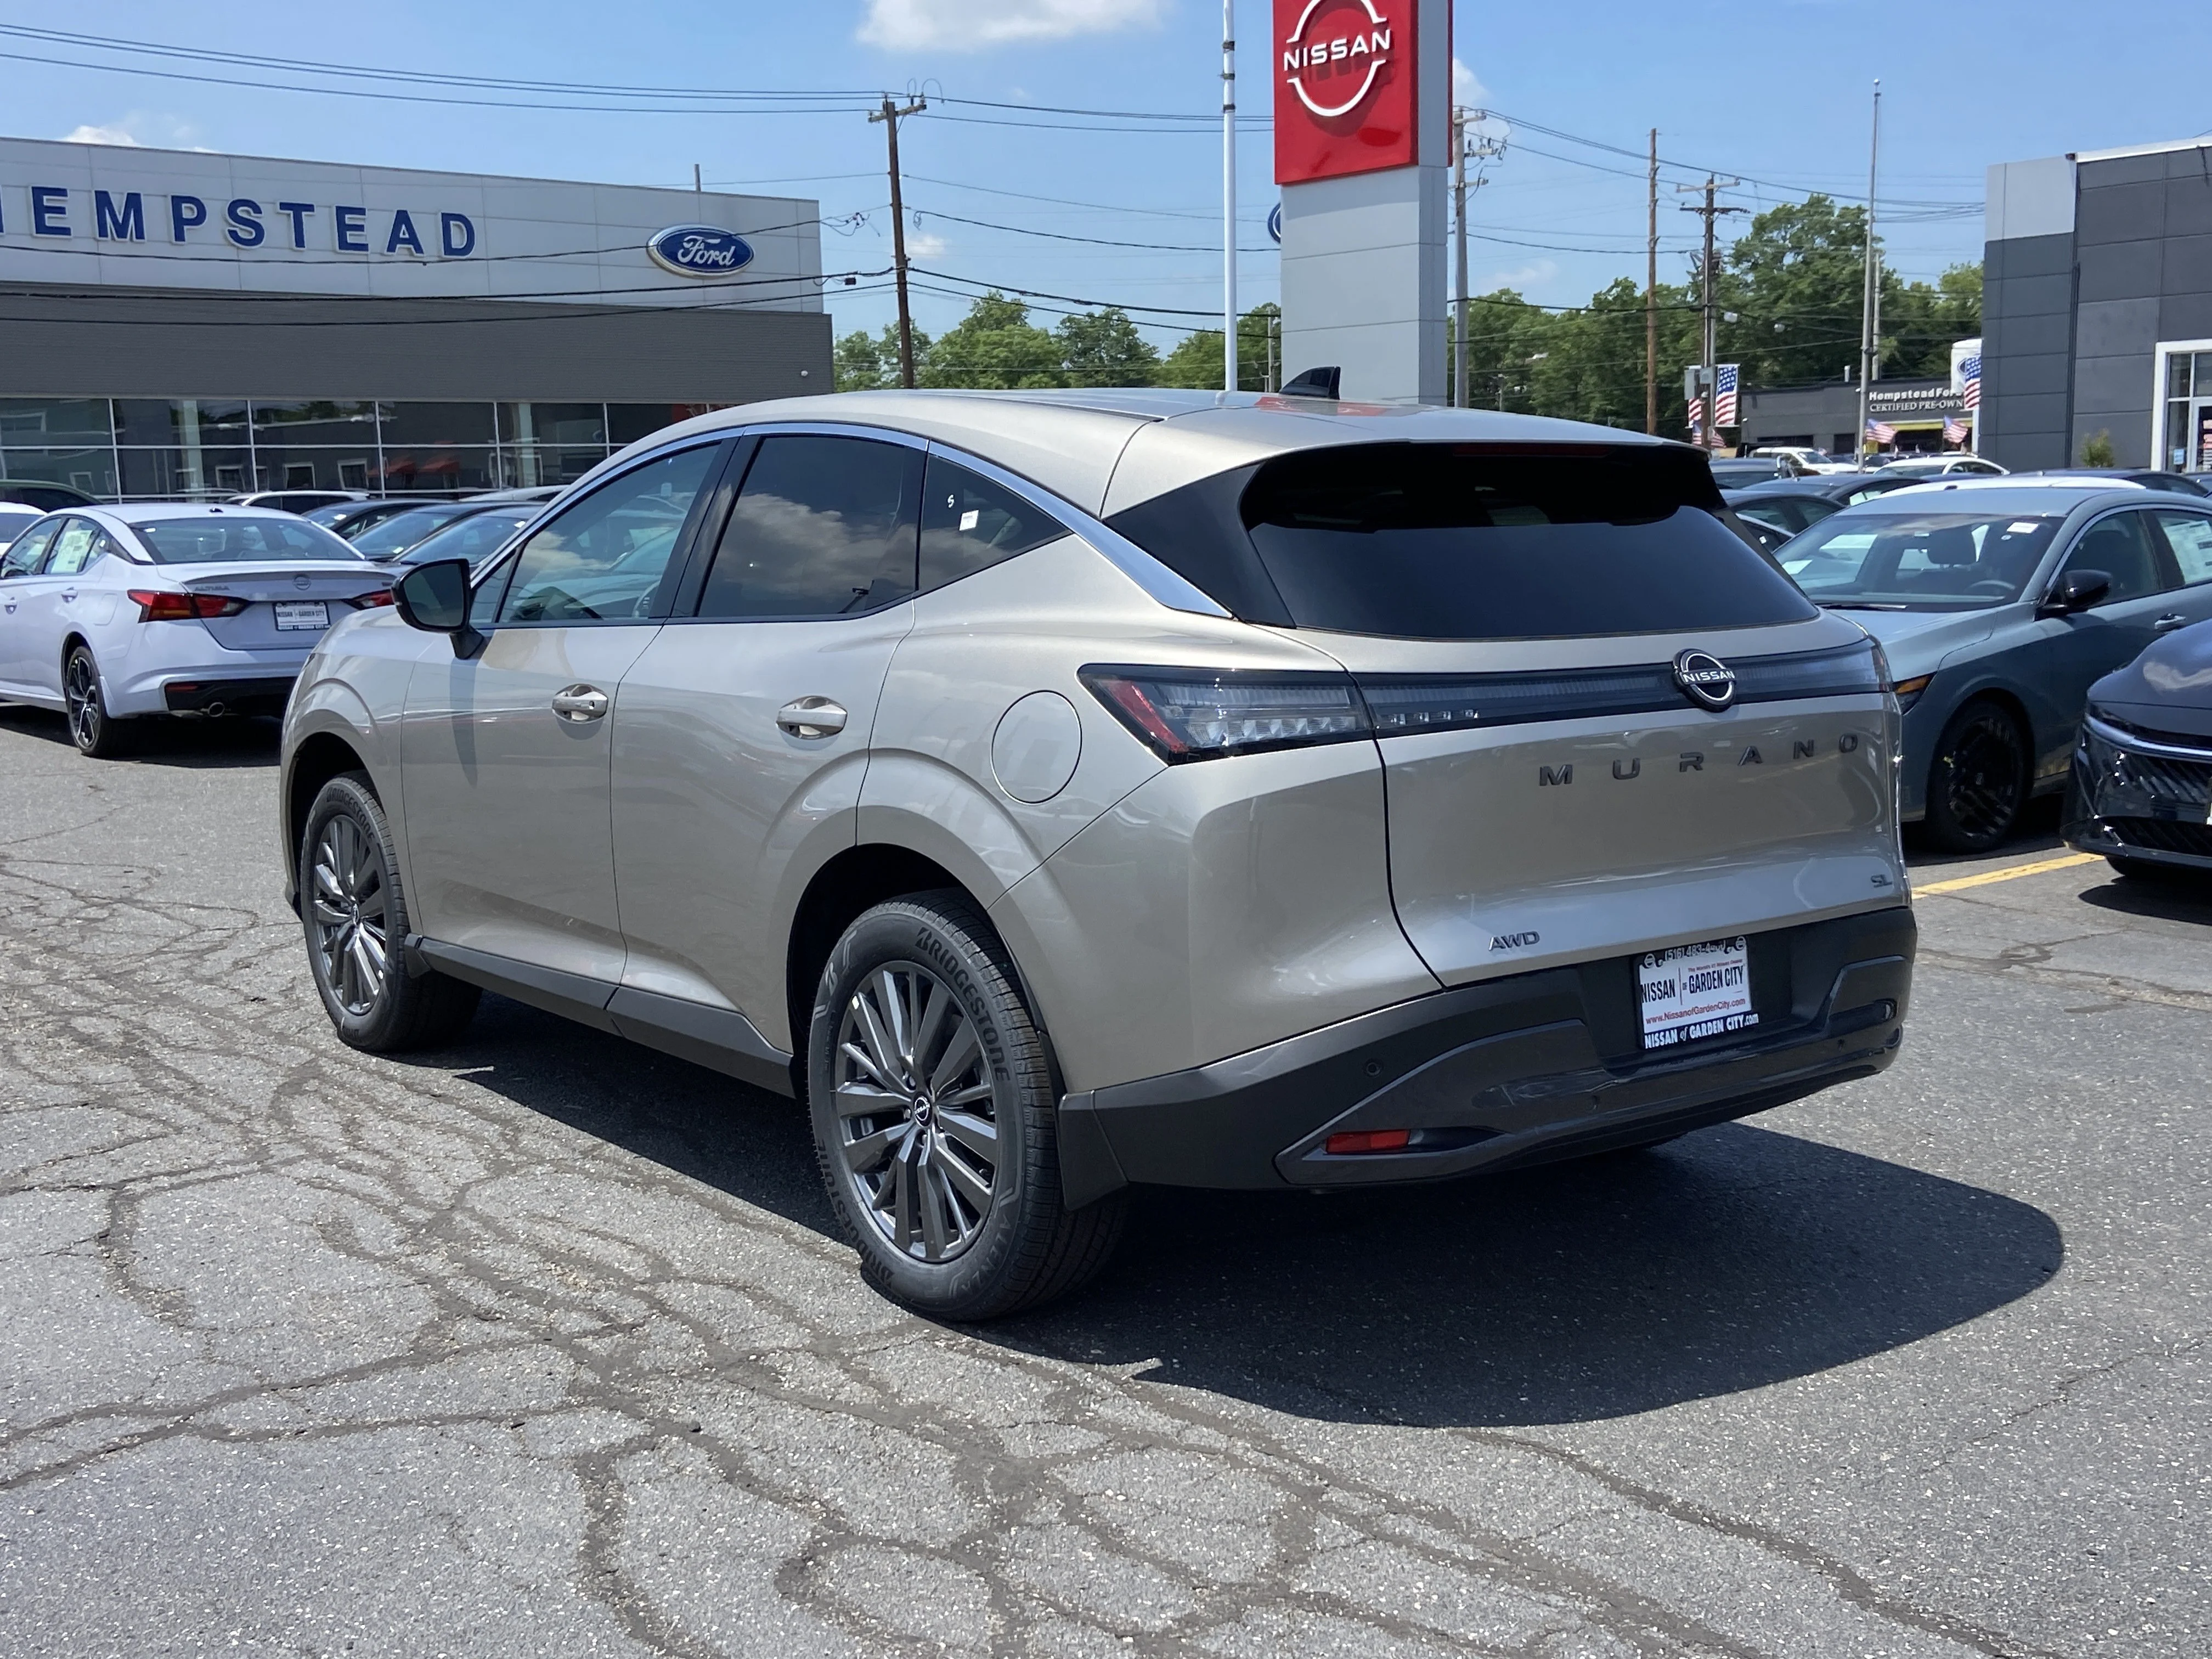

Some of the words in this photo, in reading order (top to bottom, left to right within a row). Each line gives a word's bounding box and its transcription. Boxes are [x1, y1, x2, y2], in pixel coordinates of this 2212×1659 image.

[1283, 29, 1391, 71] NISSAN
[0, 185, 476, 258] EMPSTEAD
[678, 235, 735, 267] Ford
[1870, 402, 1917, 412] CERTIFIED
[1919, 399, 1964, 410] PRE-OWN
[1683, 670, 1735, 682] NISSAN
[1539, 733, 1859, 786] MURANO
[1871, 874, 1892, 888] SL
[1488, 931, 1540, 951] AWD
[1640, 979, 1675, 1003] NISSAN
[1689, 969, 1723, 994] GARDEN
[1725, 965, 1743, 987] CITY
[915, 926, 1011, 1082] BRIDGESTONE
[1646, 997, 1746, 1024] www.NissanofGardenCity.com
[1645, 1029, 1678, 1049] NISSAN
[1680, 1026, 1688, 1041] of
[1690, 1018, 1724, 1039] GARDEN
